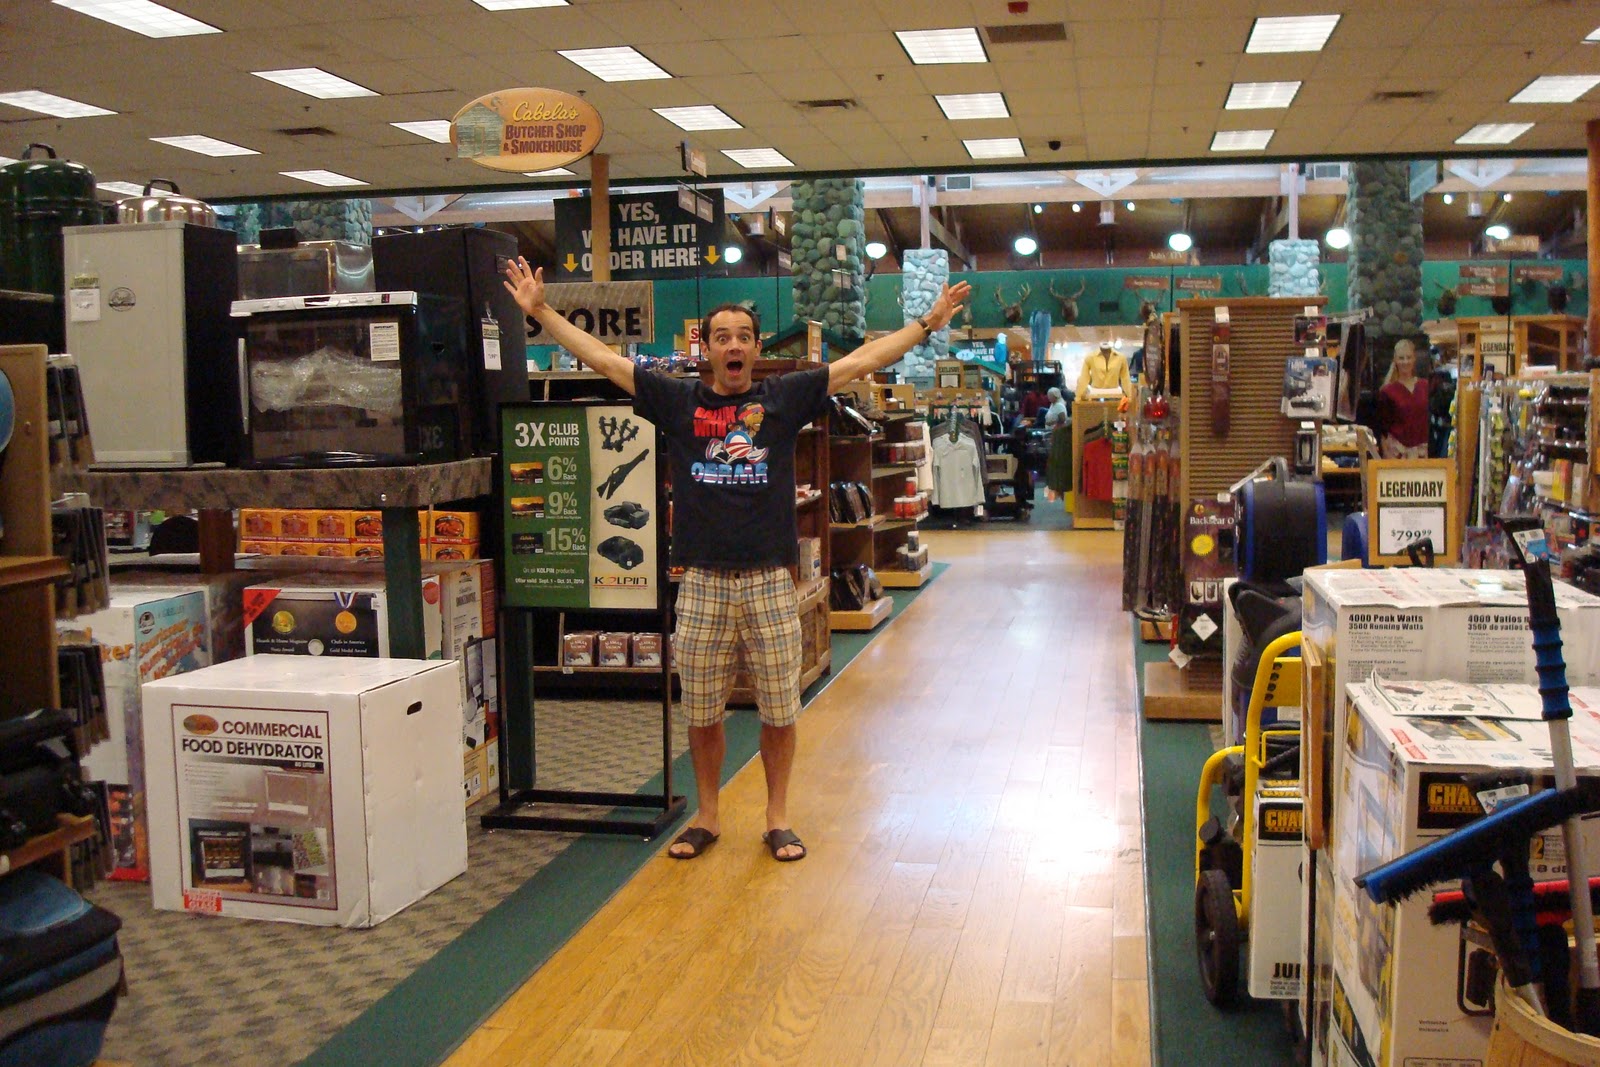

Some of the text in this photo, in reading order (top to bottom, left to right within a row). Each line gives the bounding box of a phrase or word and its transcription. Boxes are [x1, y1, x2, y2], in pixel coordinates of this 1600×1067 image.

[513, 101, 579, 122] Cabela's
[505, 123, 586, 140] BUTCHER SHOP
[503, 139, 582, 155] & SMOKEHOUSE
[618, 202, 660, 224] YES,
[618, 225, 668, 247] HAVE
[673, 223, 697, 243] IT!
[581, 250, 645, 272] ODER
[1480, 342, 1515, 352] LEGENDAY
[514, 422, 579, 447] 3X CLUB
[549, 437, 580, 447] POINTS
[547, 456, 577, 481] 6%
[1380, 481, 1443, 498] LEGENDARY
[548, 491, 578, 516] 9%
[546, 527, 586, 551] 15%
[572, 543, 586, 551] Back
[594, 576, 647, 585] KOLPIN
[1348, 614, 1423, 623] 4000 Peak Watts
[1369, 623, 1401, 631] Running
[1468, 614, 1491, 623] 4000
[1493, 614, 1522, 623] Vatios
[1468, 623, 1487, 631] 3500
[1489, 623, 1499, 631] de
[1500, 623, 1523, 631] vatios
[222, 720, 322, 739] COMMERCIAL
[182, 737, 323, 760] FOOD DEHYDRATOR
[1428, 783, 1479, 807] CHA
